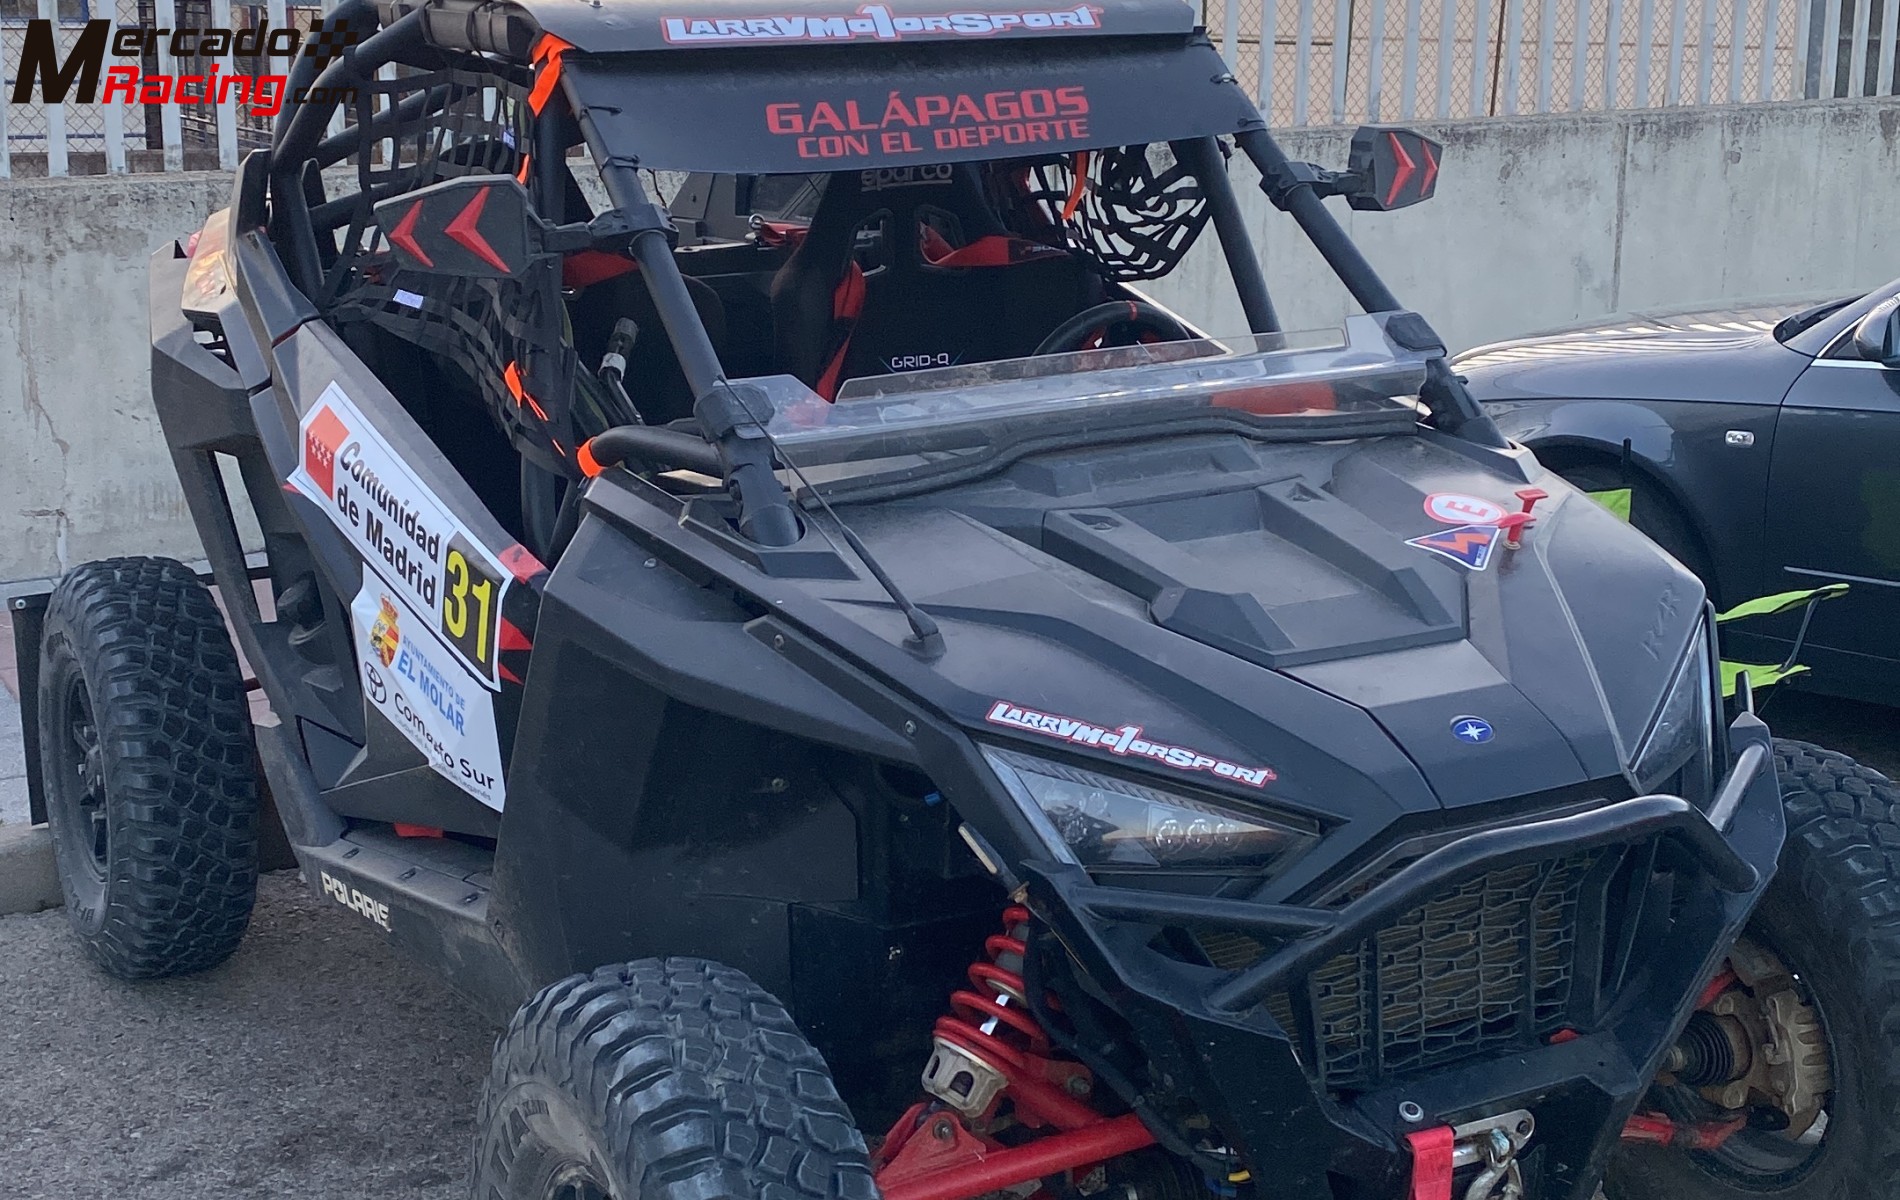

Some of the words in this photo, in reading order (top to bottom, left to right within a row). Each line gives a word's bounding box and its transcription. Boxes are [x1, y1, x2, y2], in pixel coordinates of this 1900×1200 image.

[765, 86, 1090, 135] GALÁPAGOS
[798, 134, 869, 158] CON
[881, 131, 923, 154] EL
[934, 118, 1090, 150] DEPORTE
[891, 353, 949, 368] GRID-Q
[340, 441, 440, 564] Comunidad
[337, 483, 359, 527] de
[366, 507, 436, 609] Madrid
[445, 551, 491, 663] 31
[398, 650, 416, 683] EL
[420, 670, 465, 737] MOLAR
[403, 635, 454, 698] AYUNTAMIENTO
[455, 692, 465, 711] DE
[459, 758, 495, 789] Sur
[320, 871, 388, 929] POLARIS
